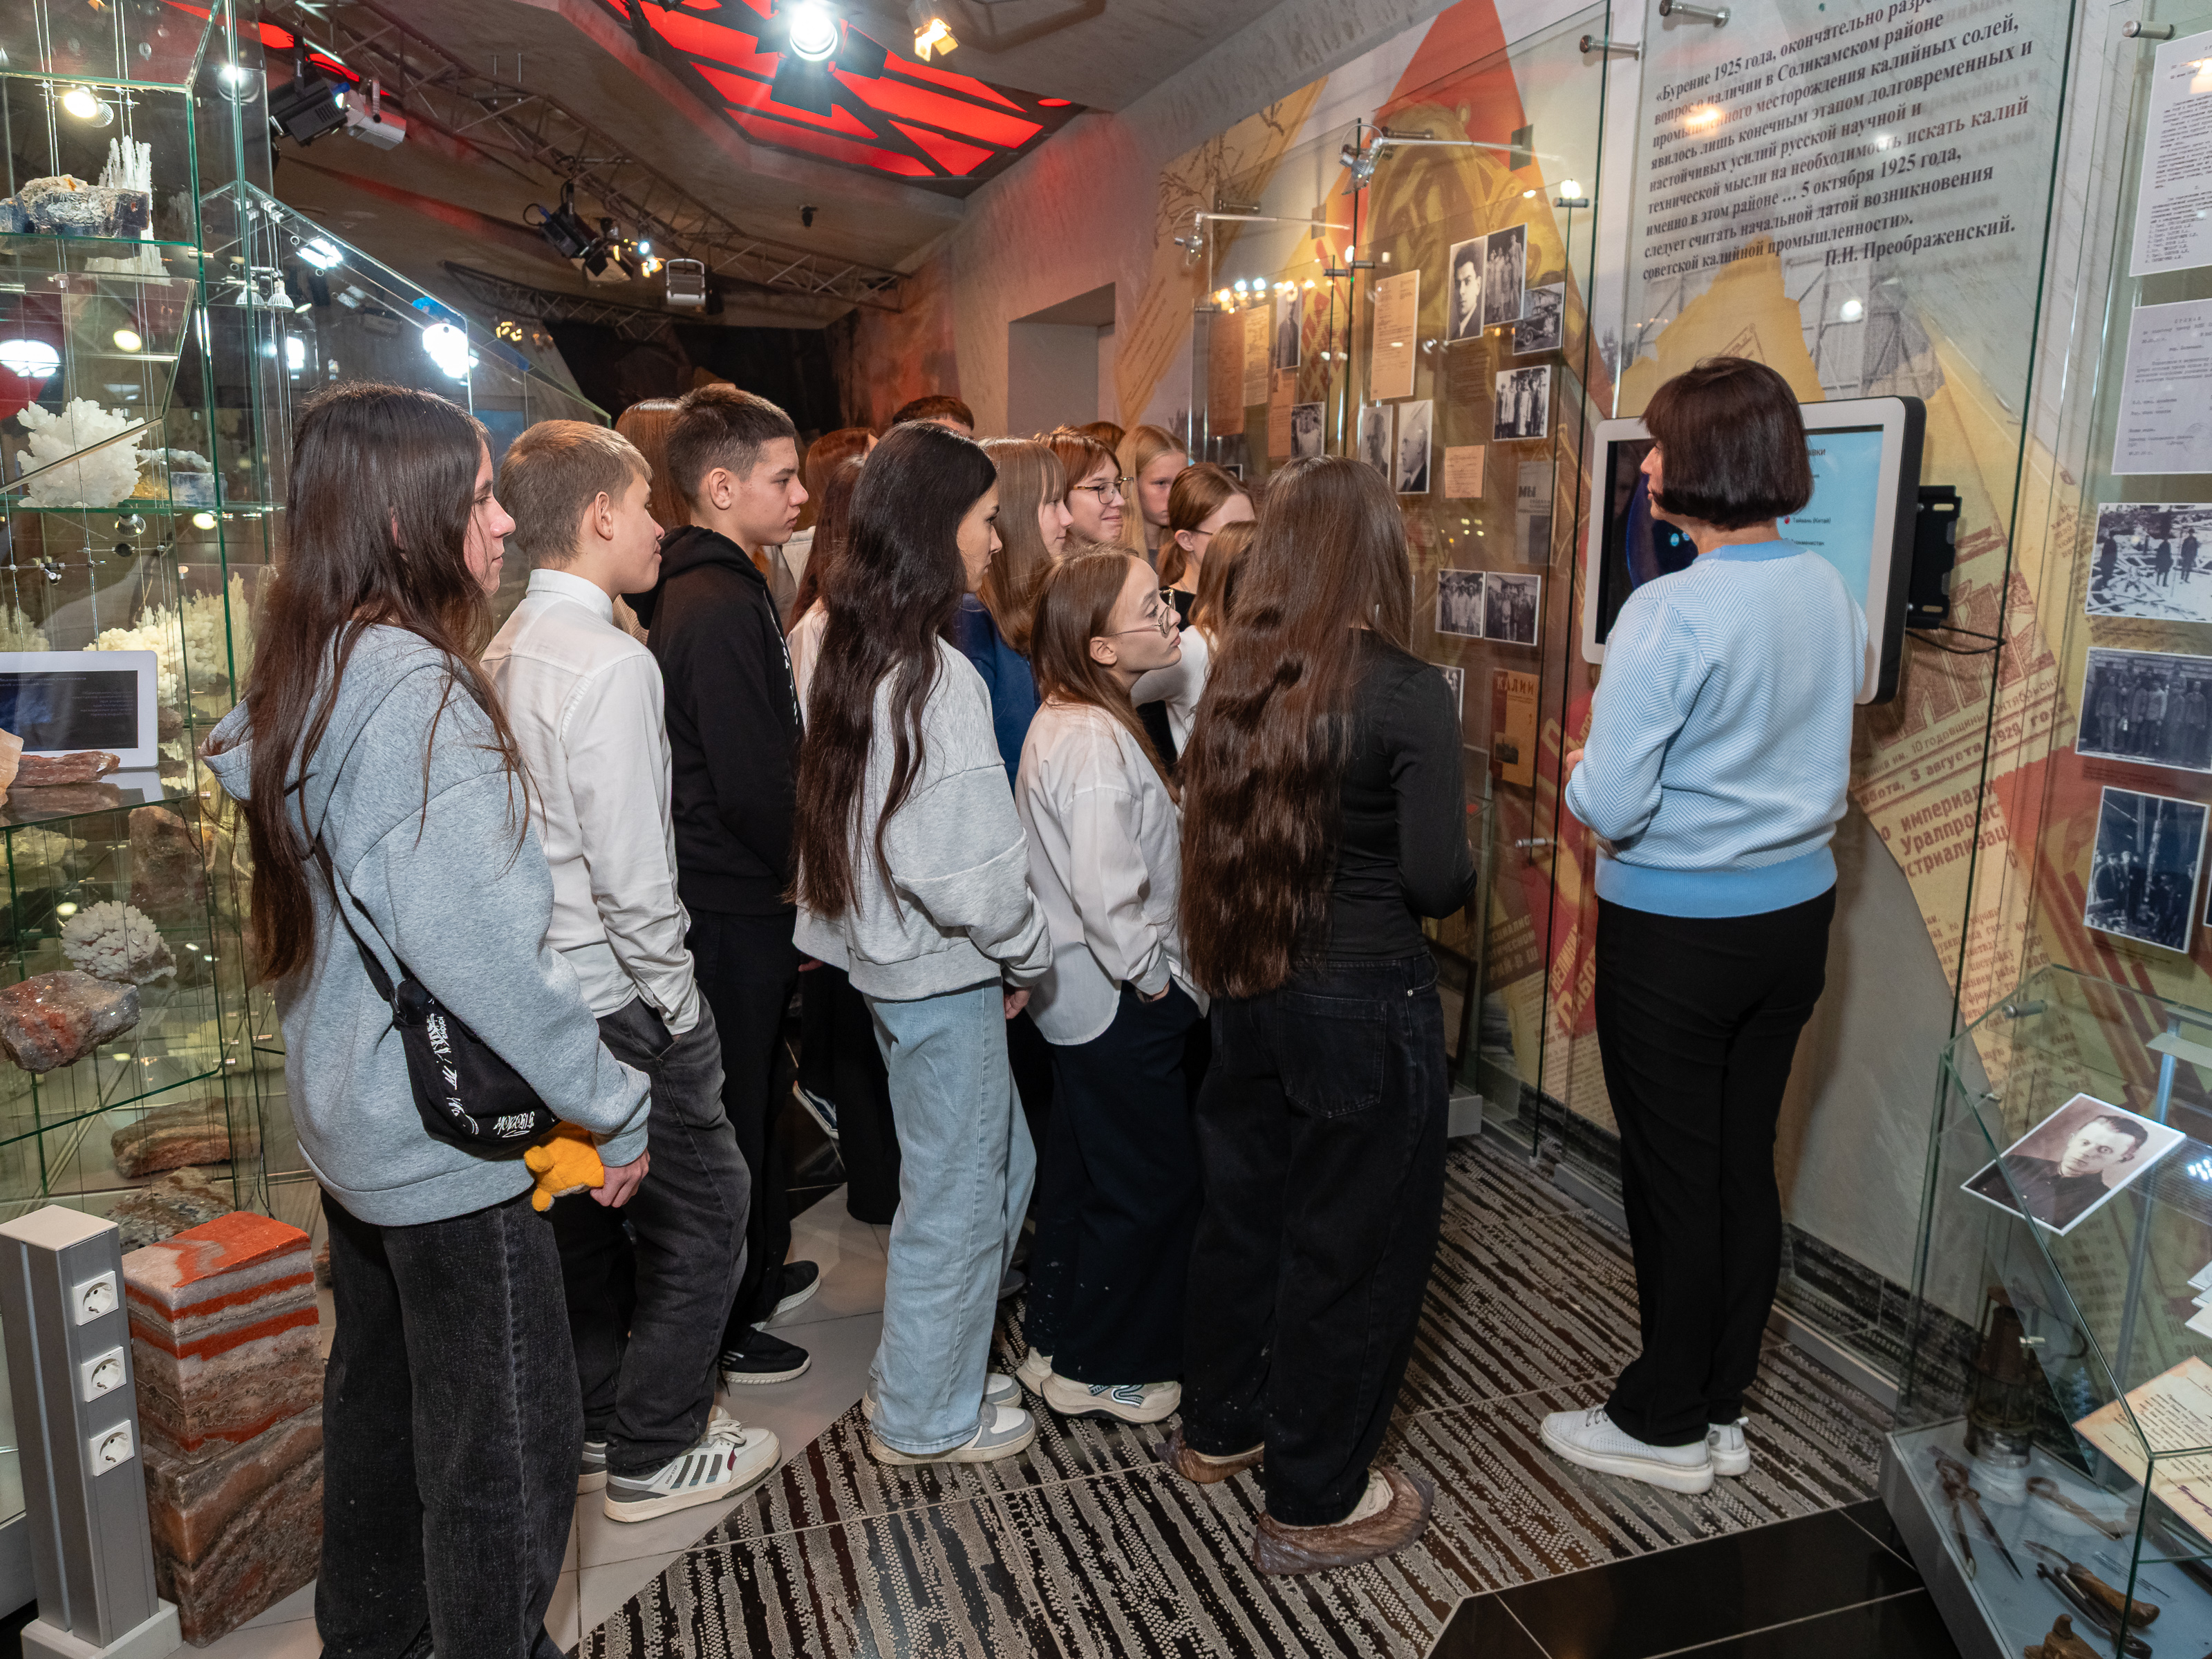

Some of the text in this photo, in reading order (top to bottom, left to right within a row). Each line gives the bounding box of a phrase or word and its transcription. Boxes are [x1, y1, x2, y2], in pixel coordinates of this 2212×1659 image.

[1654, 102, 1694, 125] вопрос
[1707, 76, 1762, 106] наличии
[1765, 73, 1774, 86] в
[1778, 35, 1880, 82] Соликамском
[1884, 13, 1944, 50] районе
[1656, 73, 1711, 102] «Бурение
[1715, 57, 1742, 82] 1925
[1745, 50, 1777, 70] года,
[1780, 8, 1884, 57] окончательно
[1755, 66, 1866, 114] месторождения
[1871, 36, 1957, 77] калийных
[1962, 12, 2019, 46] солей,
[1649, 102, 1922, 192] настойчивых усилий русской научной и
[1651, 40, 2033, 171] явилось лишь конечным этапом долговременных и
[1646, 215, 1688, 236] именно
[1690, 213, 1698, 225] в
[1701, 205, 1730, 223] этом
[1732, 192, 1779, 219] районе
[1801, 180, 1810, 198] 5
[1813, 168, 1875, 195] октября
[1880, 153, 1916, 178] 1925
[1920, 147, 1962, 169] года,
[1648, 95, 2030, 214] технической мысли на необходимость искать калий
[1642, 213, 1913, 281] советской калийной промышленности».
[1644, 166, 1994, 259] следует считать начальной датой возникновения
[1825, 214, 2016, 267] П.И. Преображенский.
[1911, 743, 1923, 754] 10
[1923, 711, 1986, 748] годовщины
[1926, 742, 1984, 776] августа
